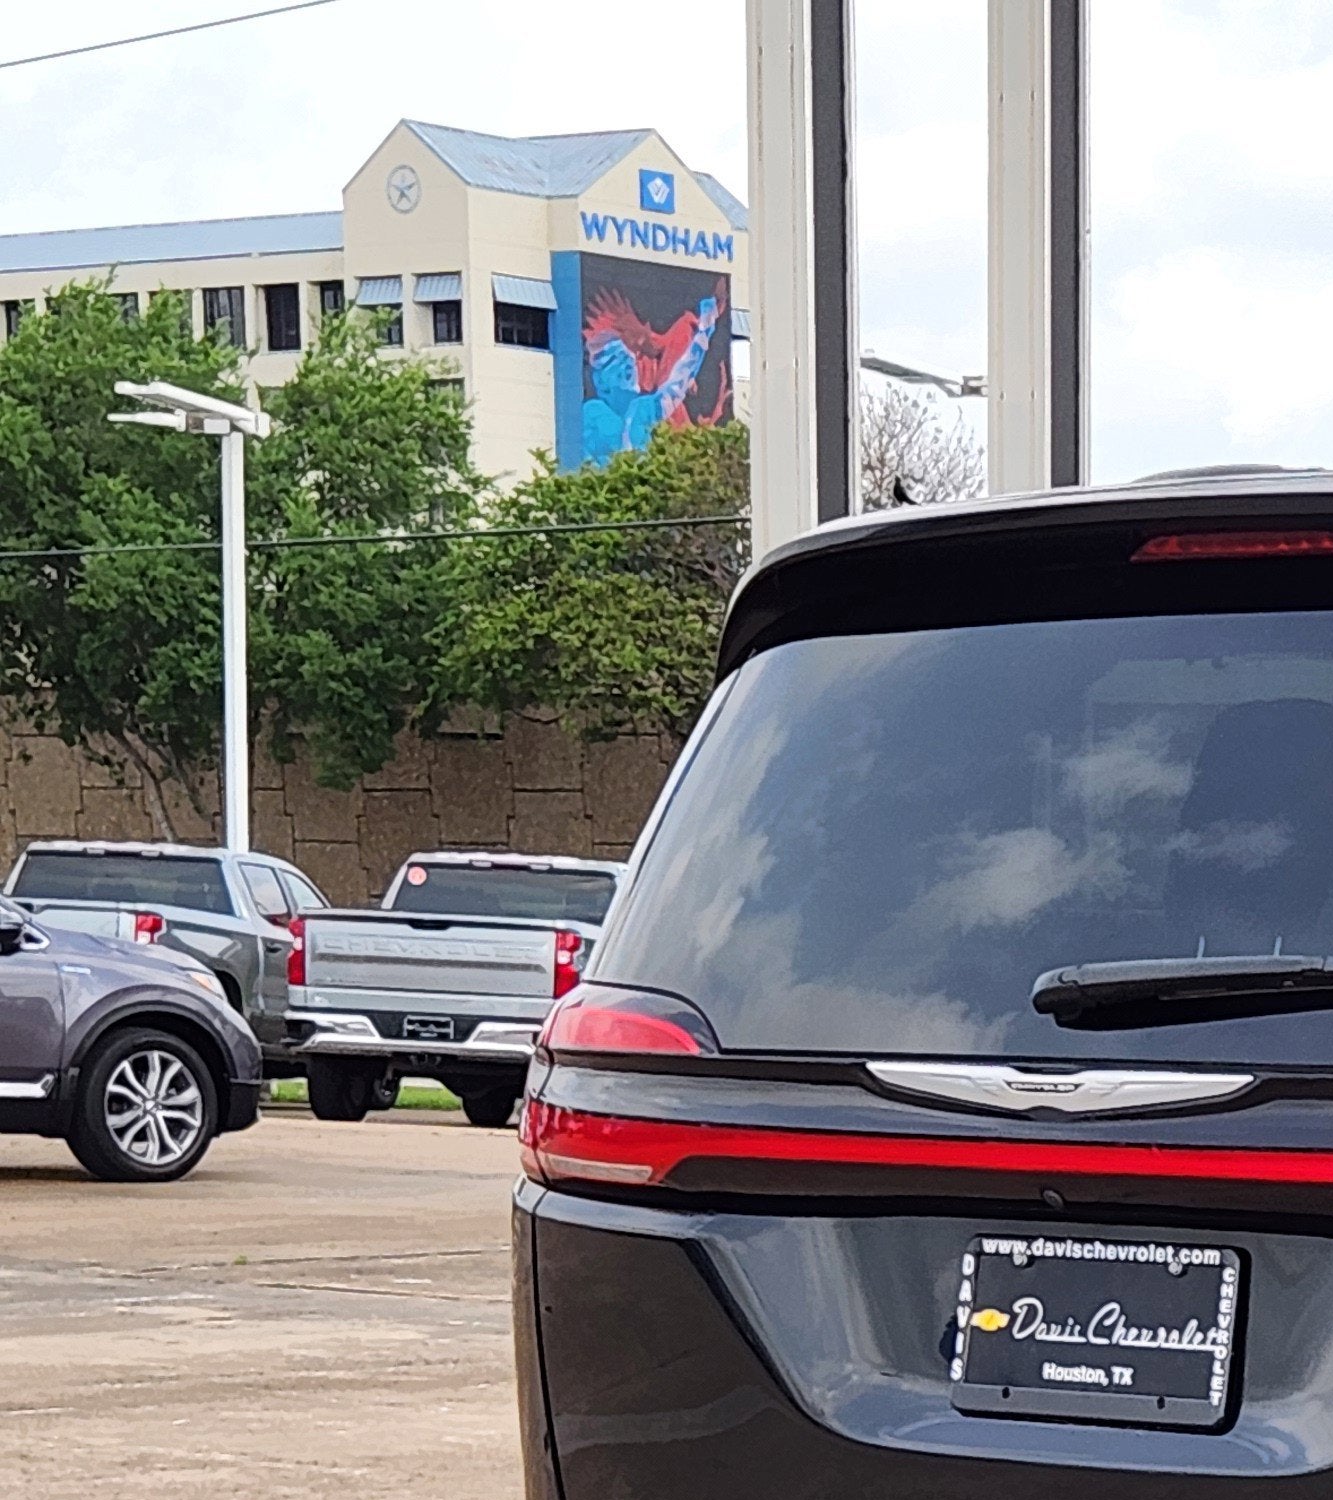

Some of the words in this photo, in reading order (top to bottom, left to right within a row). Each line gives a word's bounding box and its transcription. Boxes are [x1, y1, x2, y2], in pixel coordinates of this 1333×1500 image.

[580, 211, 734, 263] WYNDHAM
[981, 1237, 1221, 1266] www.davischevrolet.com
[950, 1253, 974, 1381] DAVIS
[1011, 1297, 1087, 1342] Davis
[1087, 1301, 1219, 1351] Chevrolet
[1208, 1266, 1236, 1406] CHEVROLET
[1042, 1361, 1109, 1387] Houston,
[1110, 1365, 1134, 1386] TX
